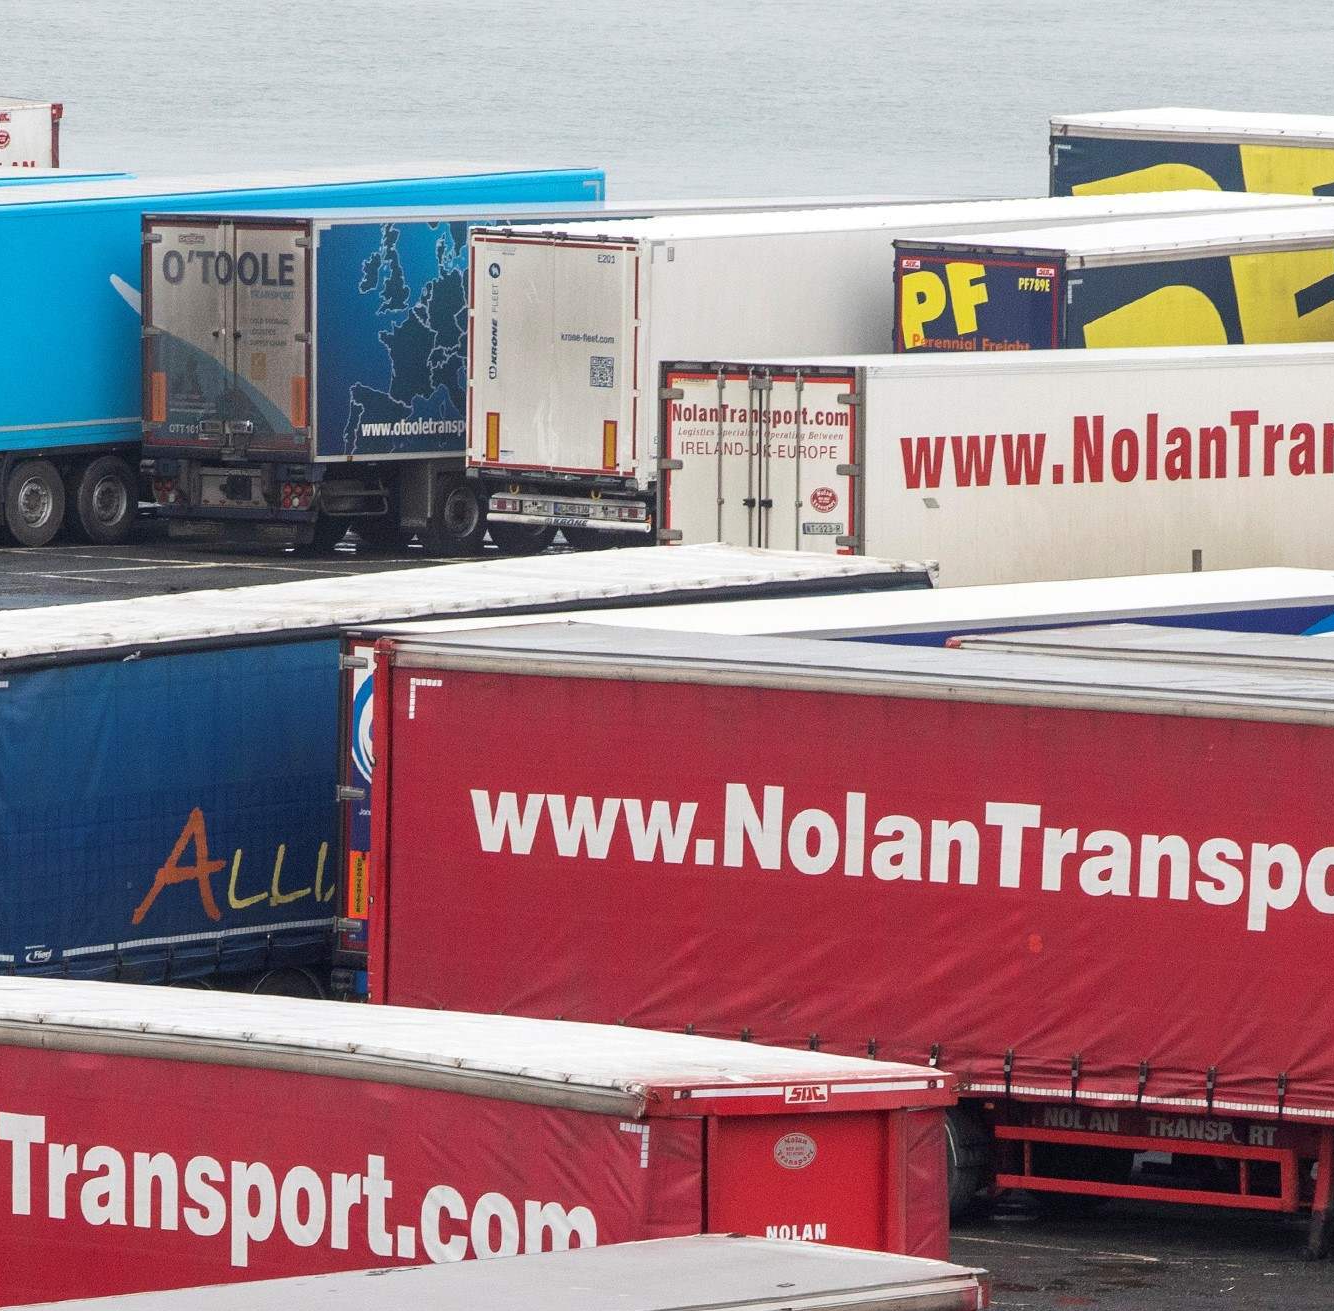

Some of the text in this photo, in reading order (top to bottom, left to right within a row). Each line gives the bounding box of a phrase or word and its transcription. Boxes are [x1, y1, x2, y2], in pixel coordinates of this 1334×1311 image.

[163, 250, 295, 287] O'TOOLE
[1019, 278, 1050, 292] PF789E
[902, 262, 989, 350] PF
[766, 1223, 827, 1241] NOLAN
